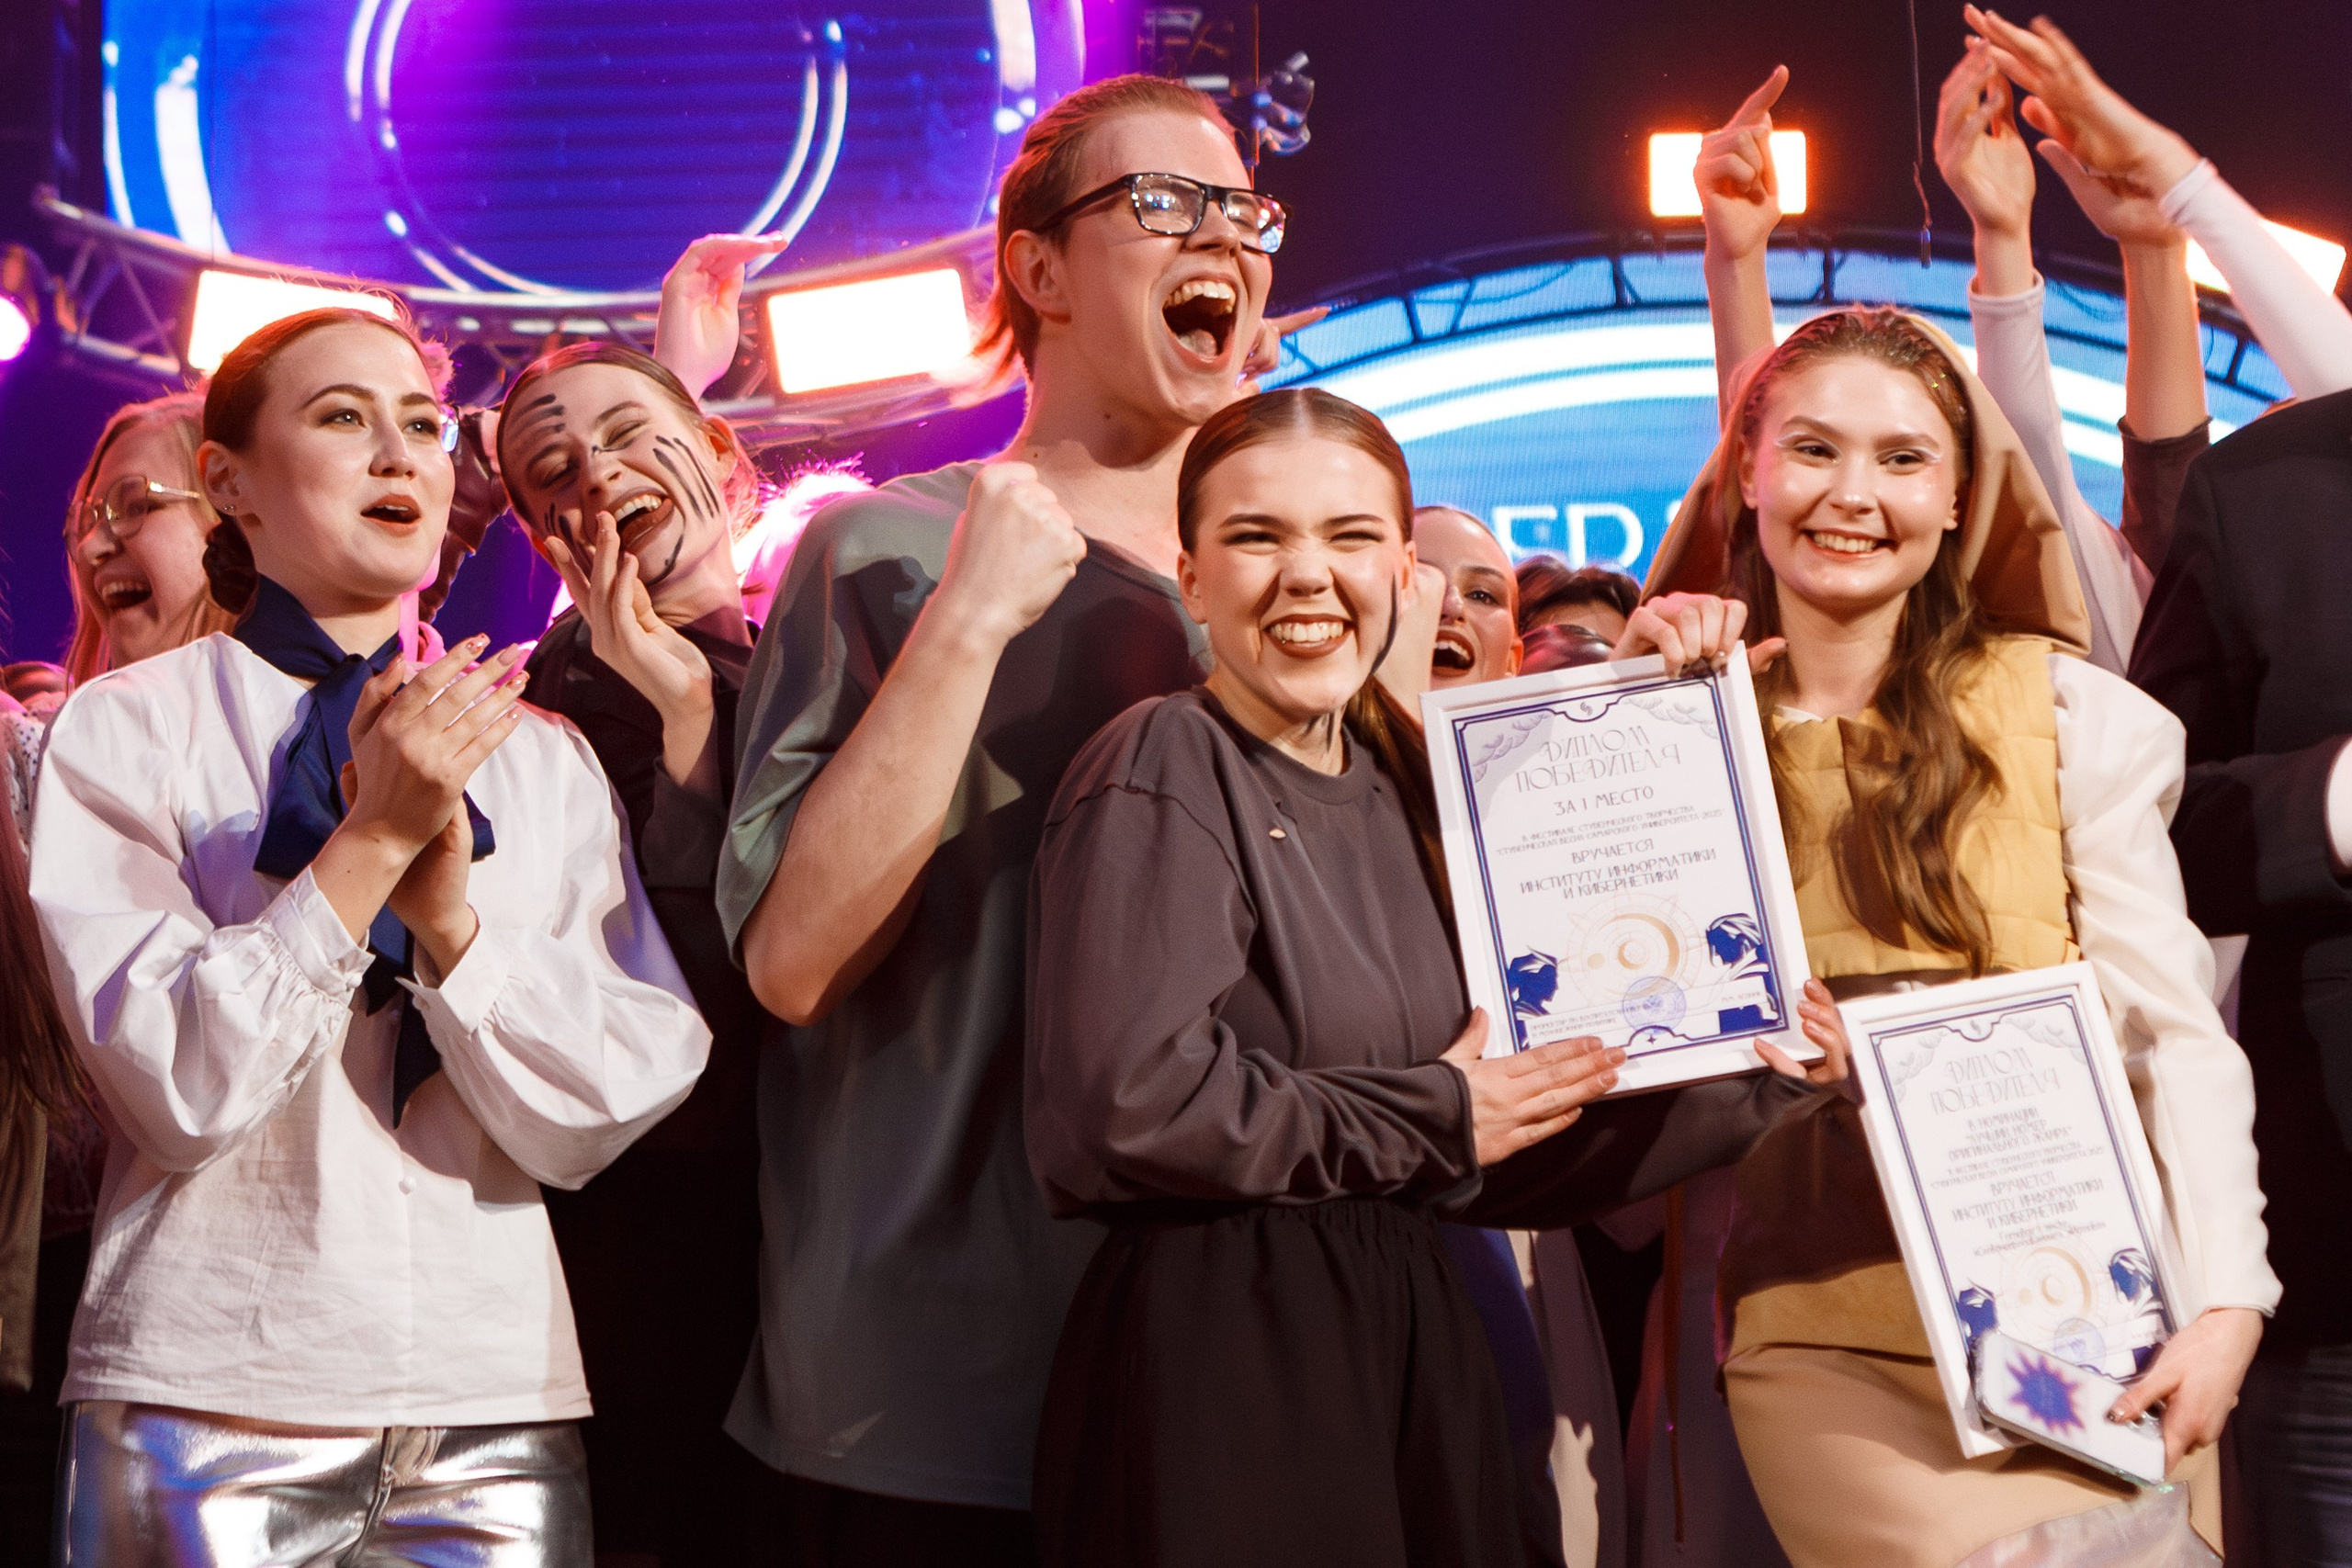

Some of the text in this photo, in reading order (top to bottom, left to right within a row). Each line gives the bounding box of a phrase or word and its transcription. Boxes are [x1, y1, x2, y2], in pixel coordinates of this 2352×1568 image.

[1516, 743, 1681, 793] ПОБЕДИТЕЛЯ
[1554, 800, 1577, 817] ЗА
[1596, 785, 1654, 808] МЕСТО
[1571, 838, 1655, 864] ВРУЧАЕТСЯ
[1520, 847, 1717, 895] ИНСТИТУТУ ИНФОРМАТИКИ
[1563, 868, 1679, 900] И КИБЕРНЕТИКИ
[1990, 1170, 2056, 1197] ВРУЧАЕТСЯ
[1951, 1178, 2105, 1224] ИНСТИТУТУ ИНФОРМАТИКИ
